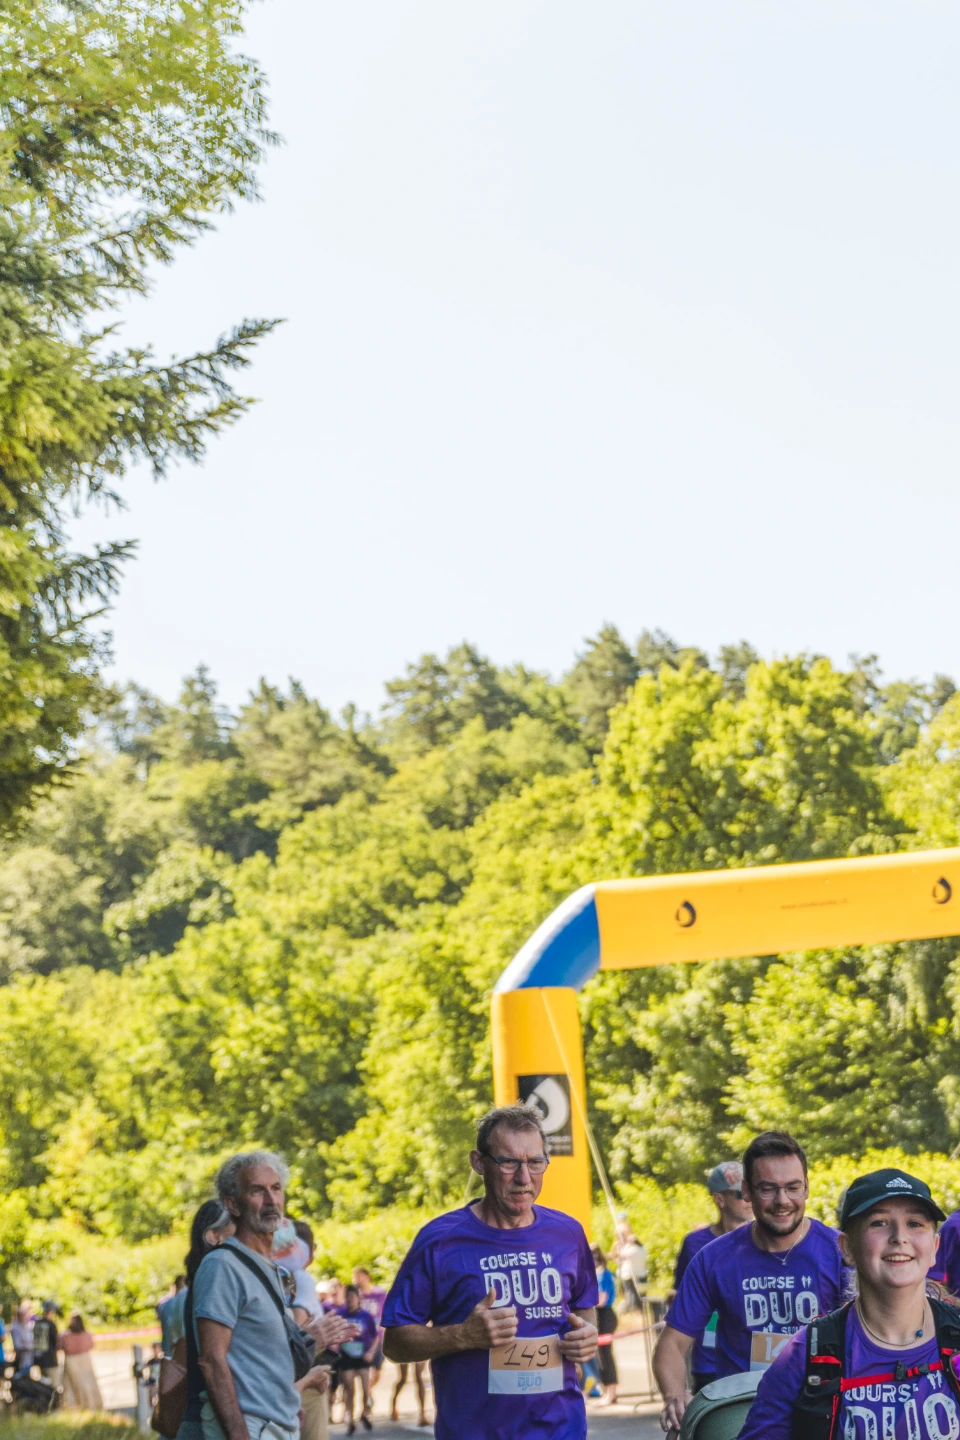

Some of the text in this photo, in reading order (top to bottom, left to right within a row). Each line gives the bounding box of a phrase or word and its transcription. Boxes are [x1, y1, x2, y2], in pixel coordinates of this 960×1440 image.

[479, 1252, 537, 1271] COURSE
[483, 1267, 562, 1308] DUO
[742, 1276, 795, 1291] COURSE
[525, 1306, 562, 1320] SUISSE
[743, 1291, 818, 1327] DUO
[503, 1343, 550, 1368] 149
[517, 1376, 543, 1388] DUO
